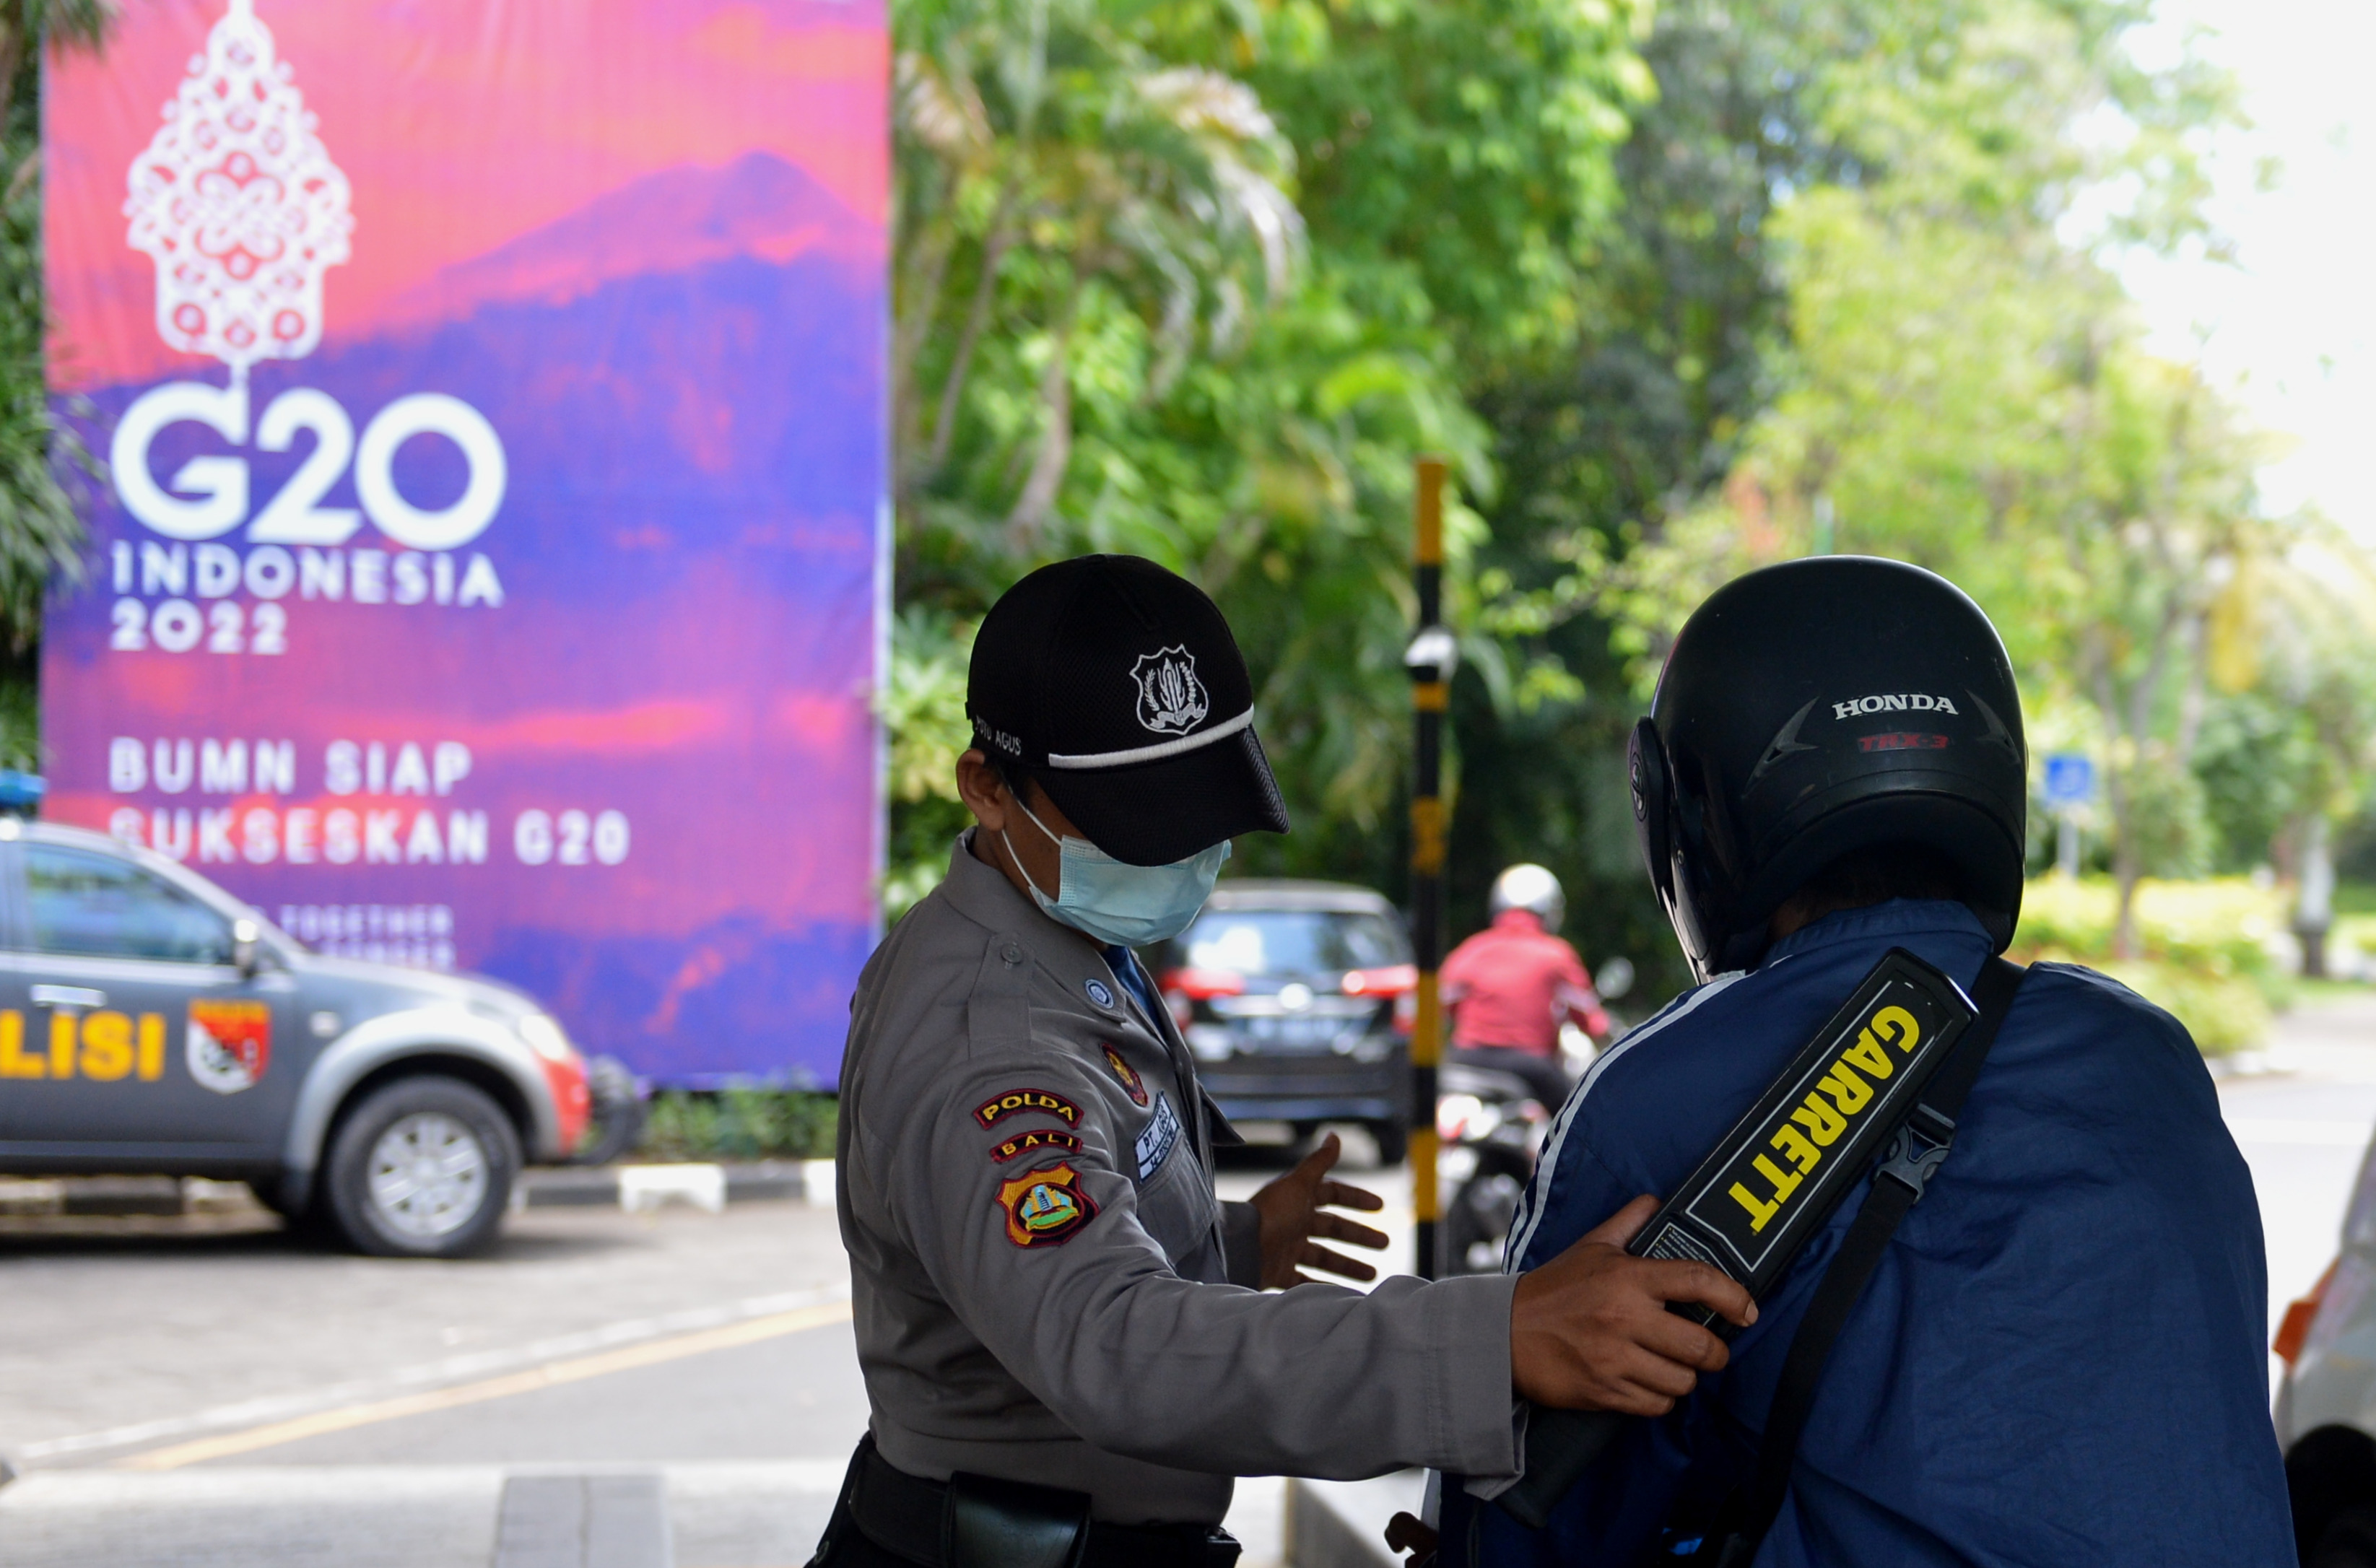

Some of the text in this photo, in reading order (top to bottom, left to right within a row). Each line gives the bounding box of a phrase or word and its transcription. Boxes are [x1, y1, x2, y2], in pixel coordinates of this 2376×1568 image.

[111, 382, 508, 551] G20
[111, 539, 505, 607] INDONESIA
[110, 598, 287, 655] 2022
[1832, 694, 1959, 720] HONDA
[109, 737, 472, 796] BUMN SIAP
[996, 729, 1022, 756] AGUS
[1859, 733, 1949, 752] TRX-3
[513, 808, 631, 866] G20
[983, 1093, 1074, 1121] POLDA
[1728, 1006, 1920, 1233] GARRETT
[1001, 1133, 1073, 1155] BALI
